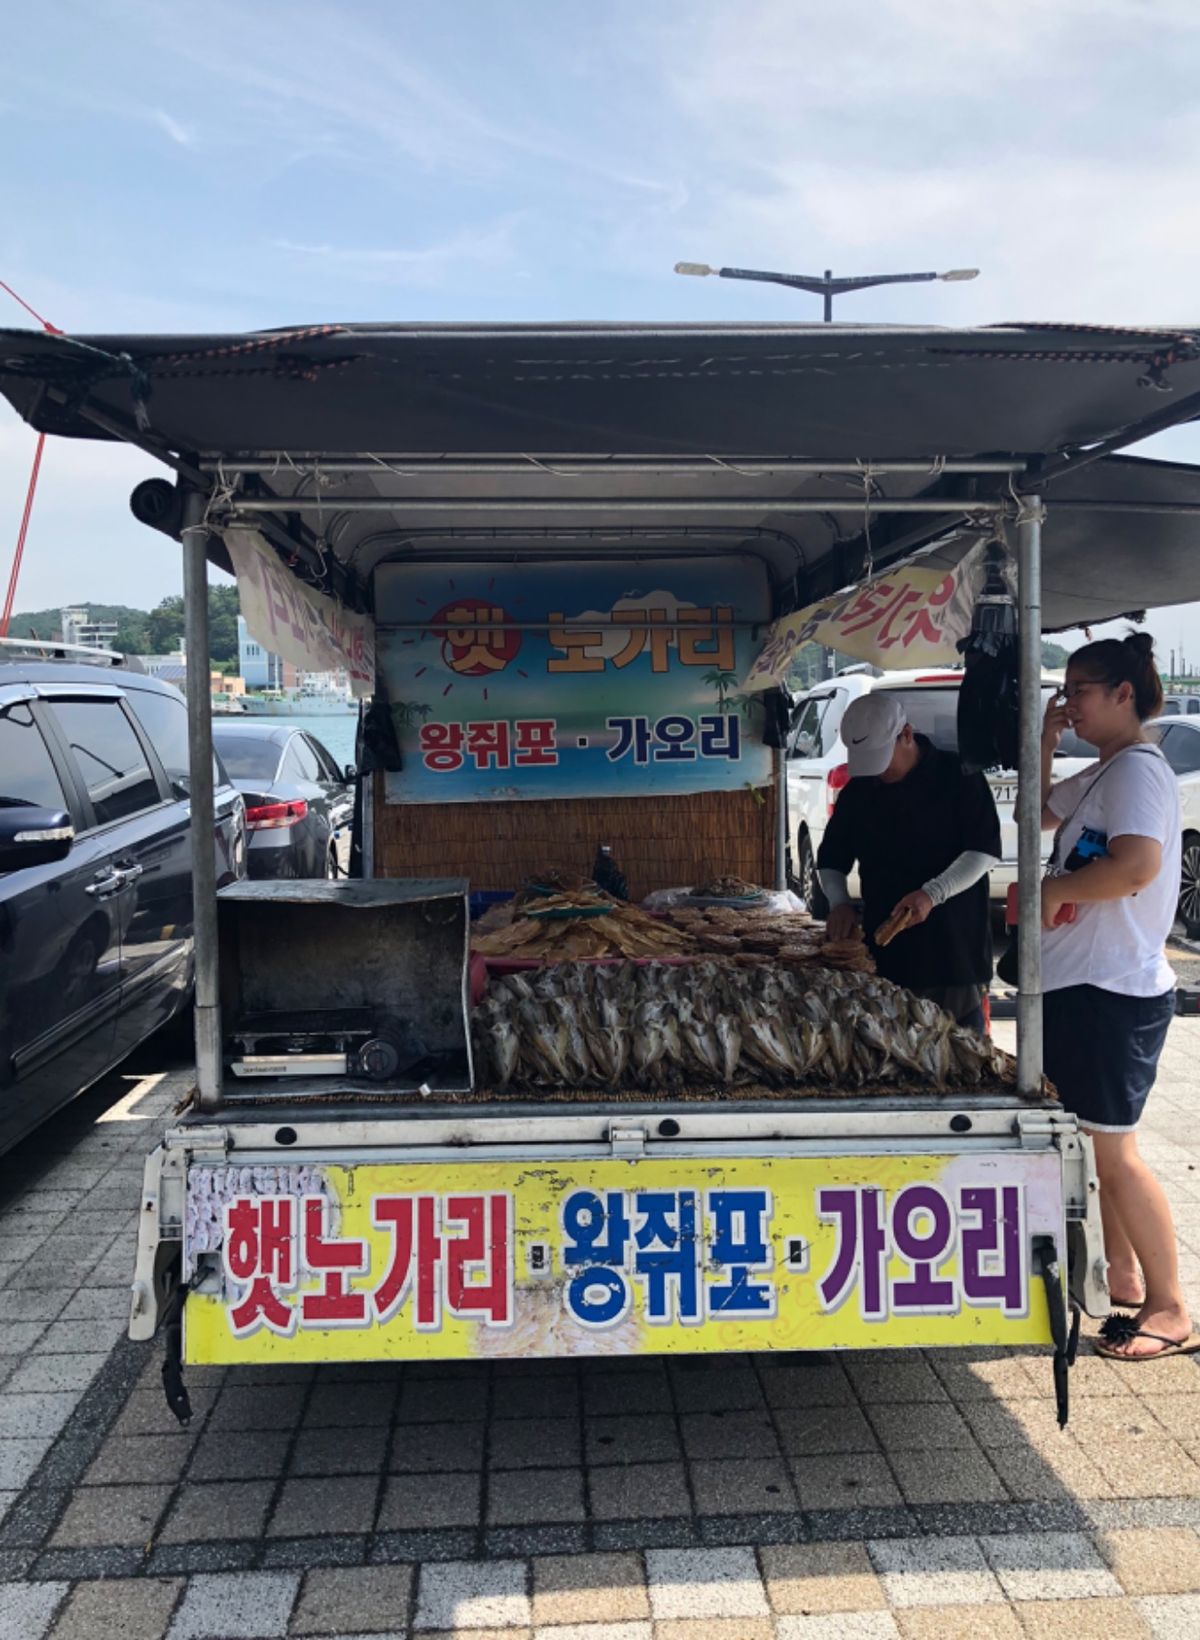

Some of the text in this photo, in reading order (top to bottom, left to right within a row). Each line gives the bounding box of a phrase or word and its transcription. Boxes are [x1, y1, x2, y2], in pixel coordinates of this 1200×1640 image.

[444, 607, 507, 673] 햇
[546, 606, 737, 673] 노가리
[419, 714, 742, 772] 왕쥐포 가오리
[225, 1185, 1023, 1332] 햇노가리 왕쥐포 가오리
